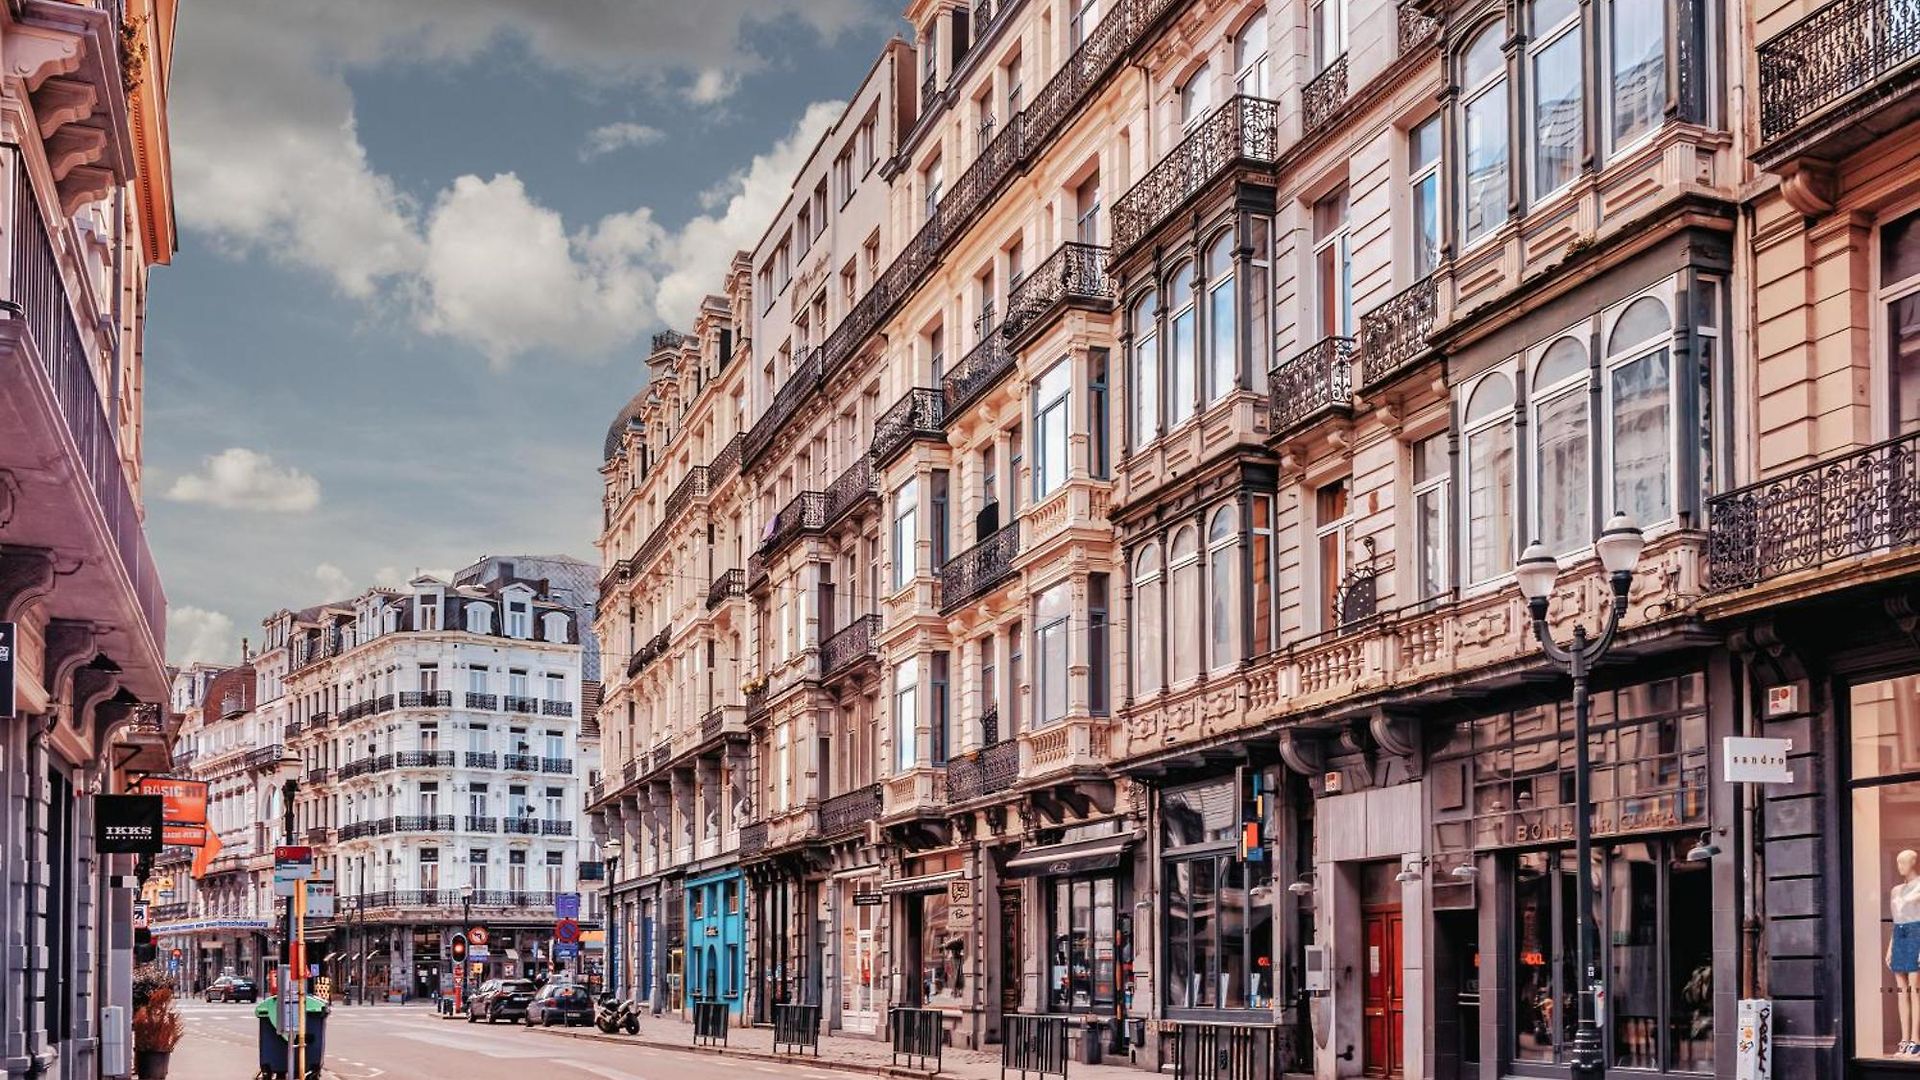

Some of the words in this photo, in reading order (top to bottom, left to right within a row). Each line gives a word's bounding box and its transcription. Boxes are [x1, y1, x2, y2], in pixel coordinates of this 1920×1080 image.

[1733, 755, 1784, 765] sandro
[105, 826, 152, 835] IKKS
[1516, 818, 1612, 842] BONSIR
